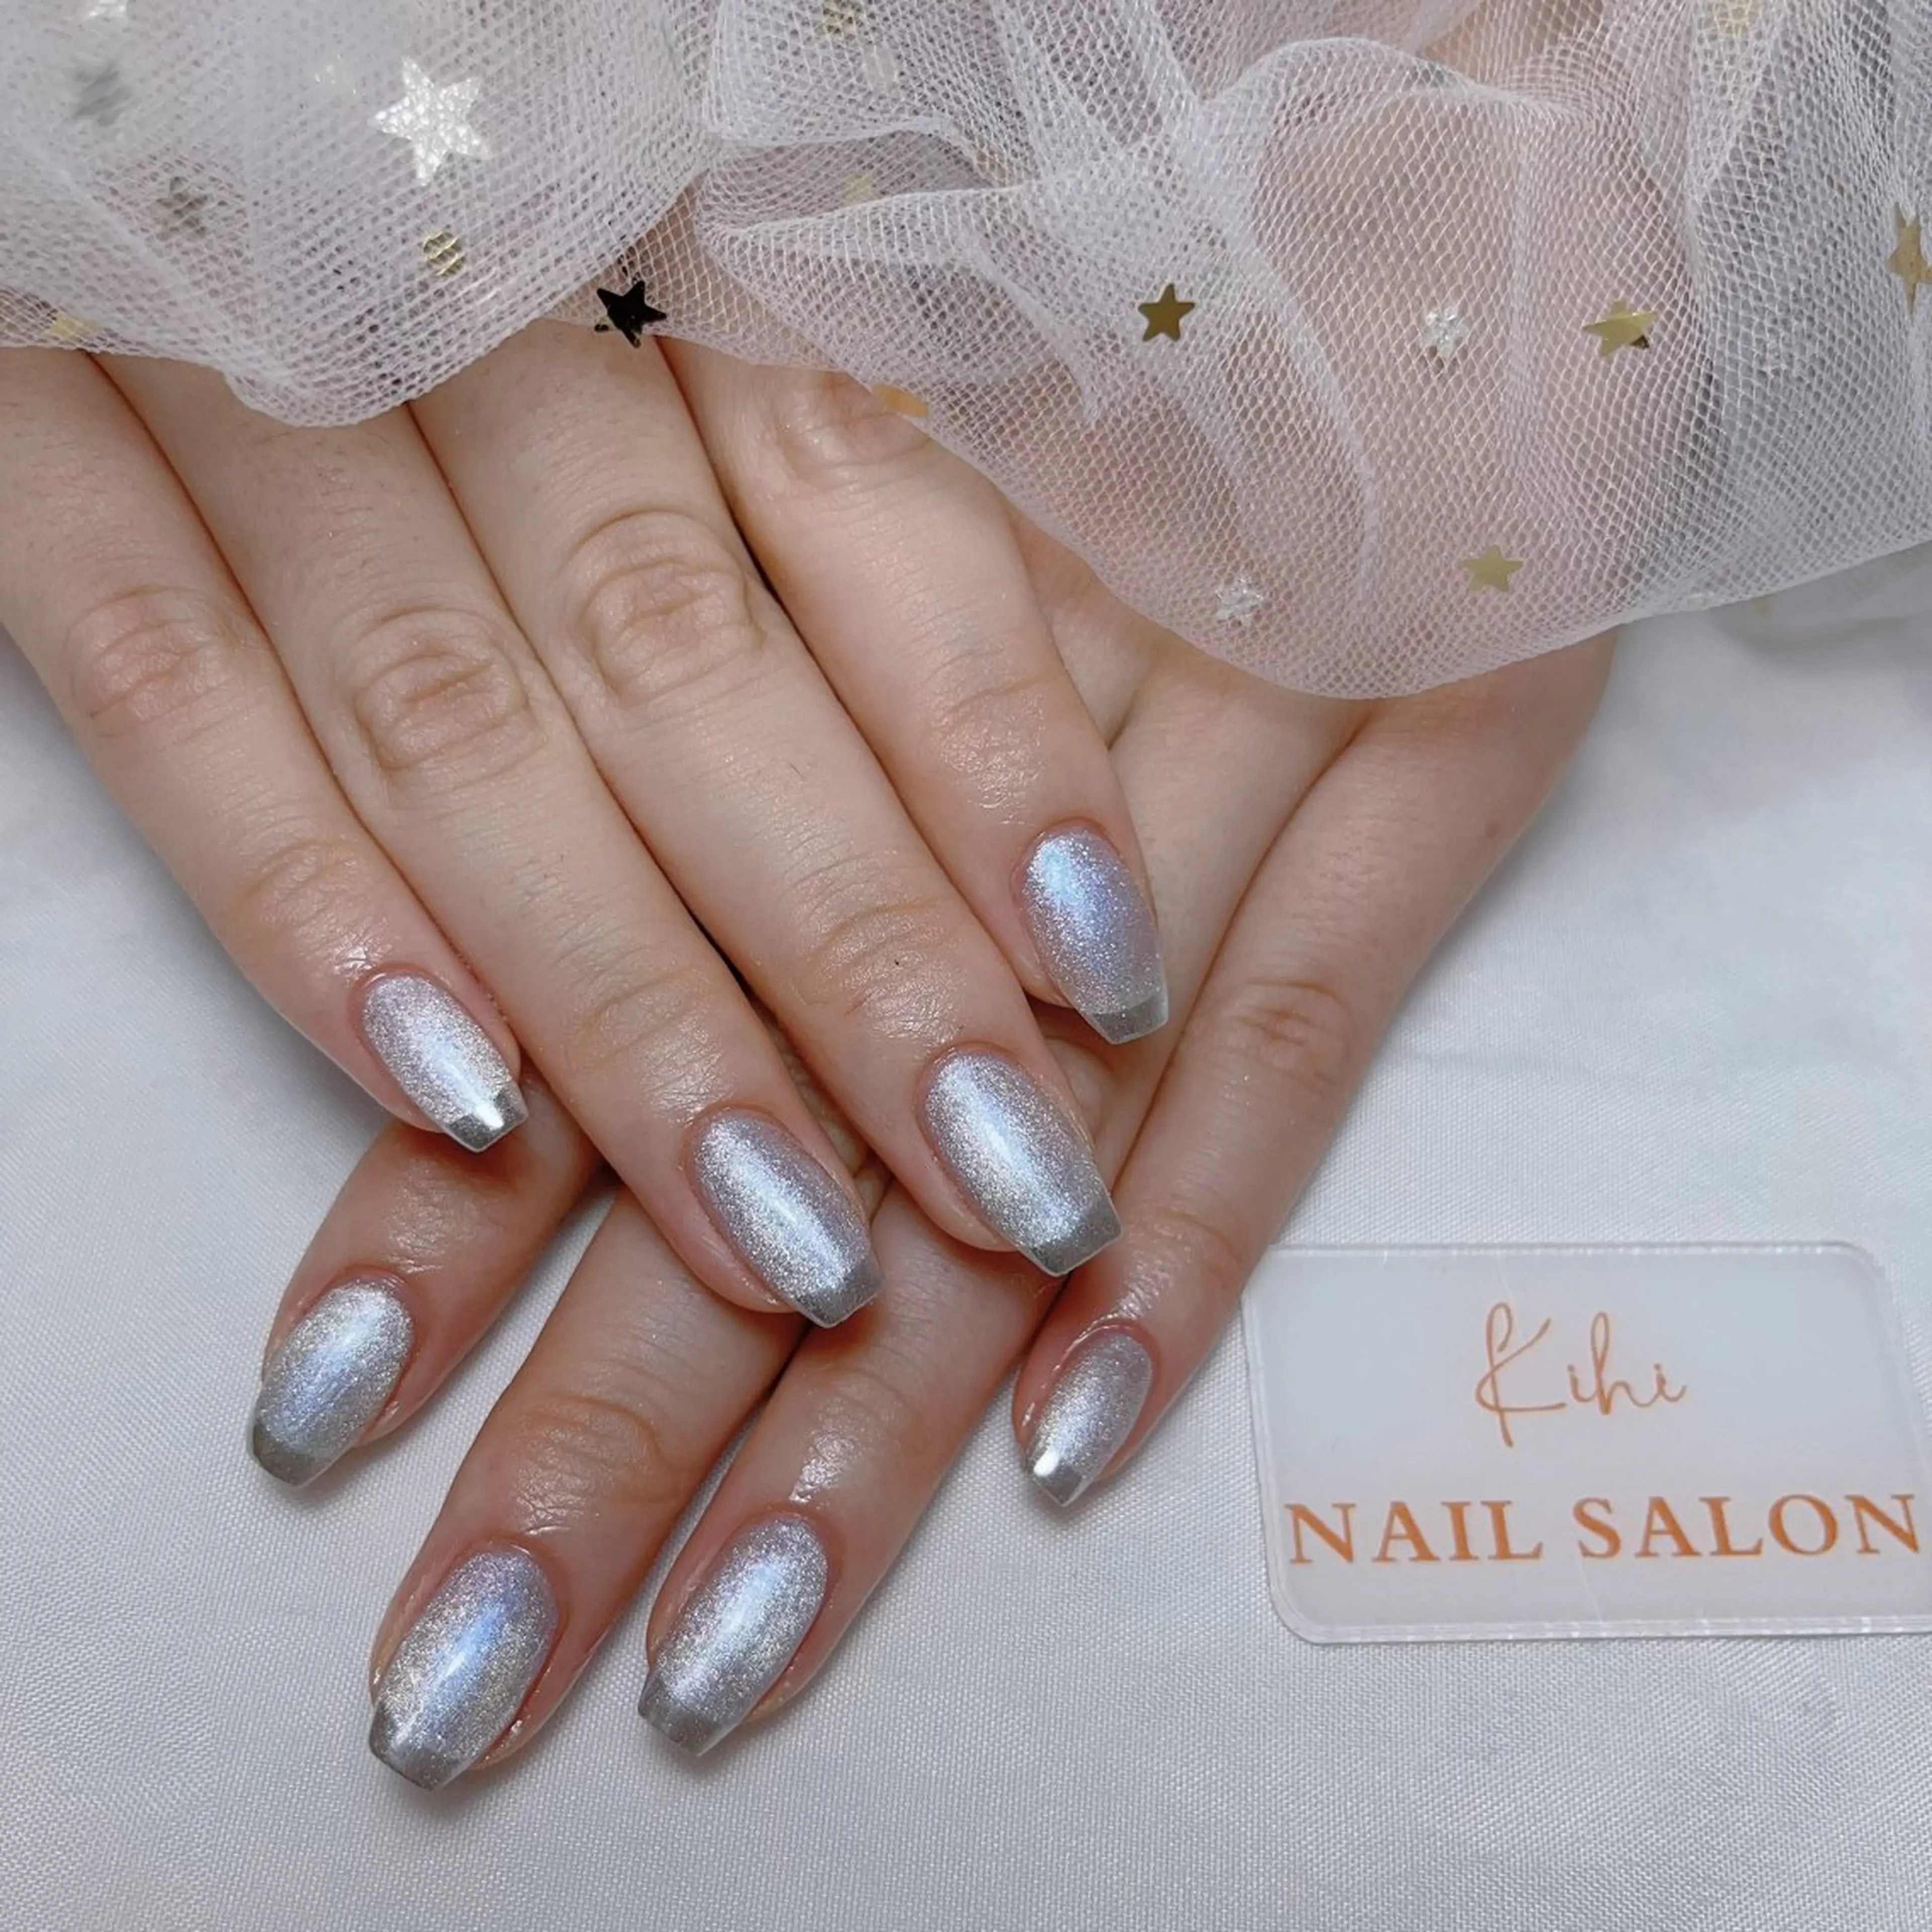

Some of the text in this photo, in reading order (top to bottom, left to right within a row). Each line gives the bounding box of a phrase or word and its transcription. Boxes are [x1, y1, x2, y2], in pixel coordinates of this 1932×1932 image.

[1475, 1302, 1687, 1447] Kihi
[1284, 1493, 1920, 1565] NAIL SALON
